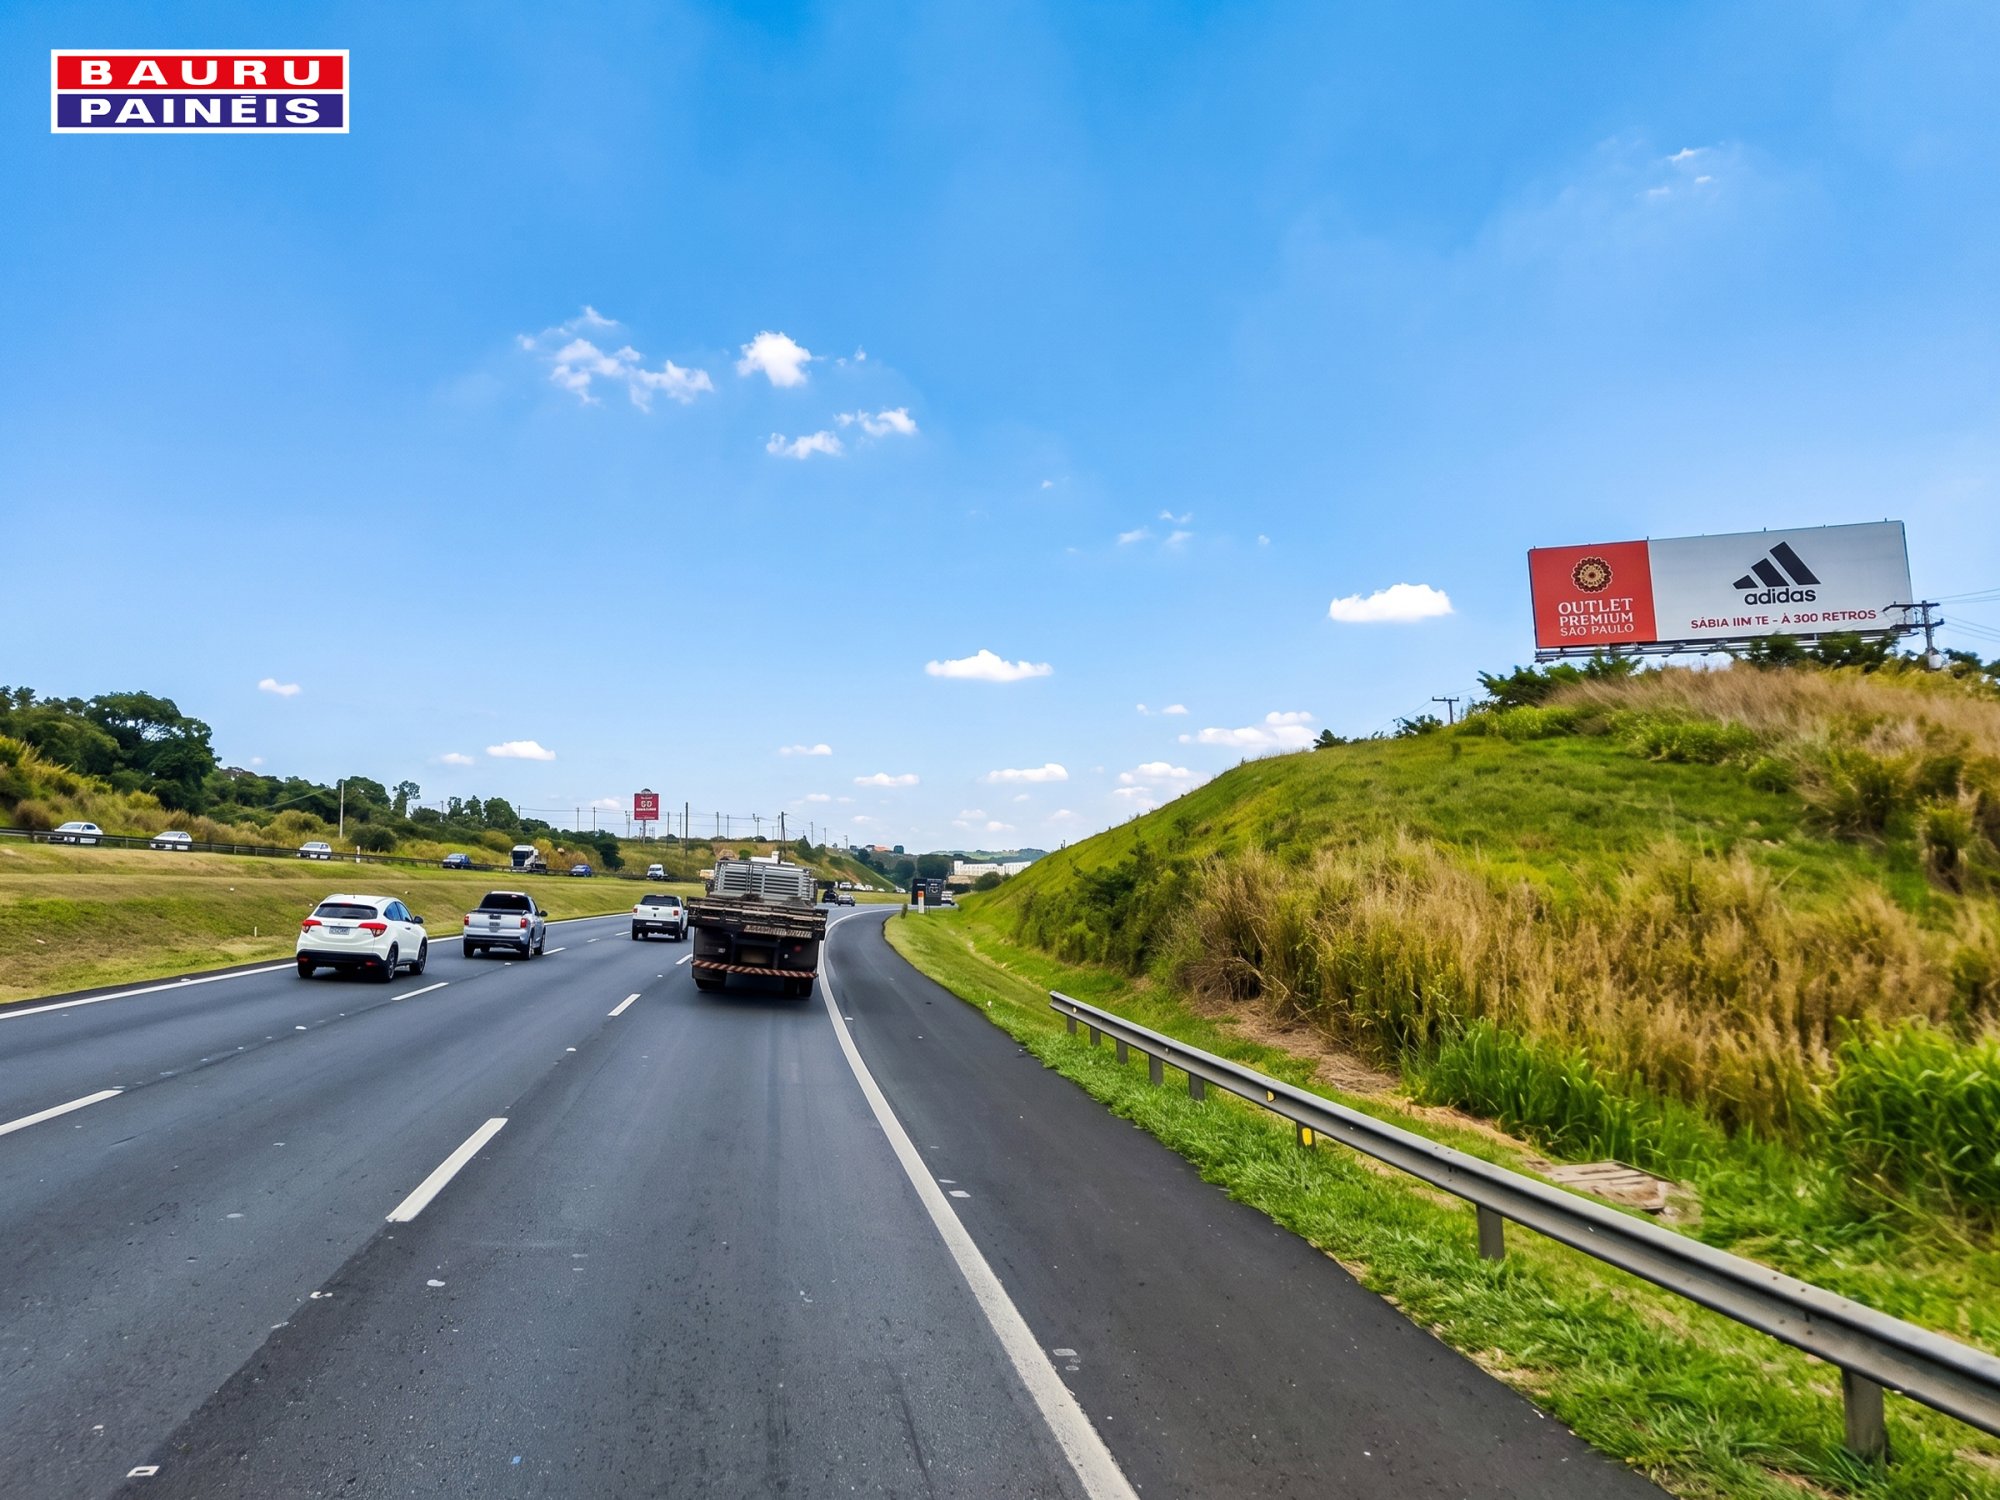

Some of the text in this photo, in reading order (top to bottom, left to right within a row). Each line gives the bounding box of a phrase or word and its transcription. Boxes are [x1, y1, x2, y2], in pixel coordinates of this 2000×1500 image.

[1744, 587, 1817, 605] adidas
[1558, 598, 1633, 614] OUTLET
[1559, 612, 1633, 626] PREMIUM
[1794, 612, 1819, 623] 300
[1822, 609, 1877, 622] RETROS
[1591, 624, 1634, 634] PAULO
